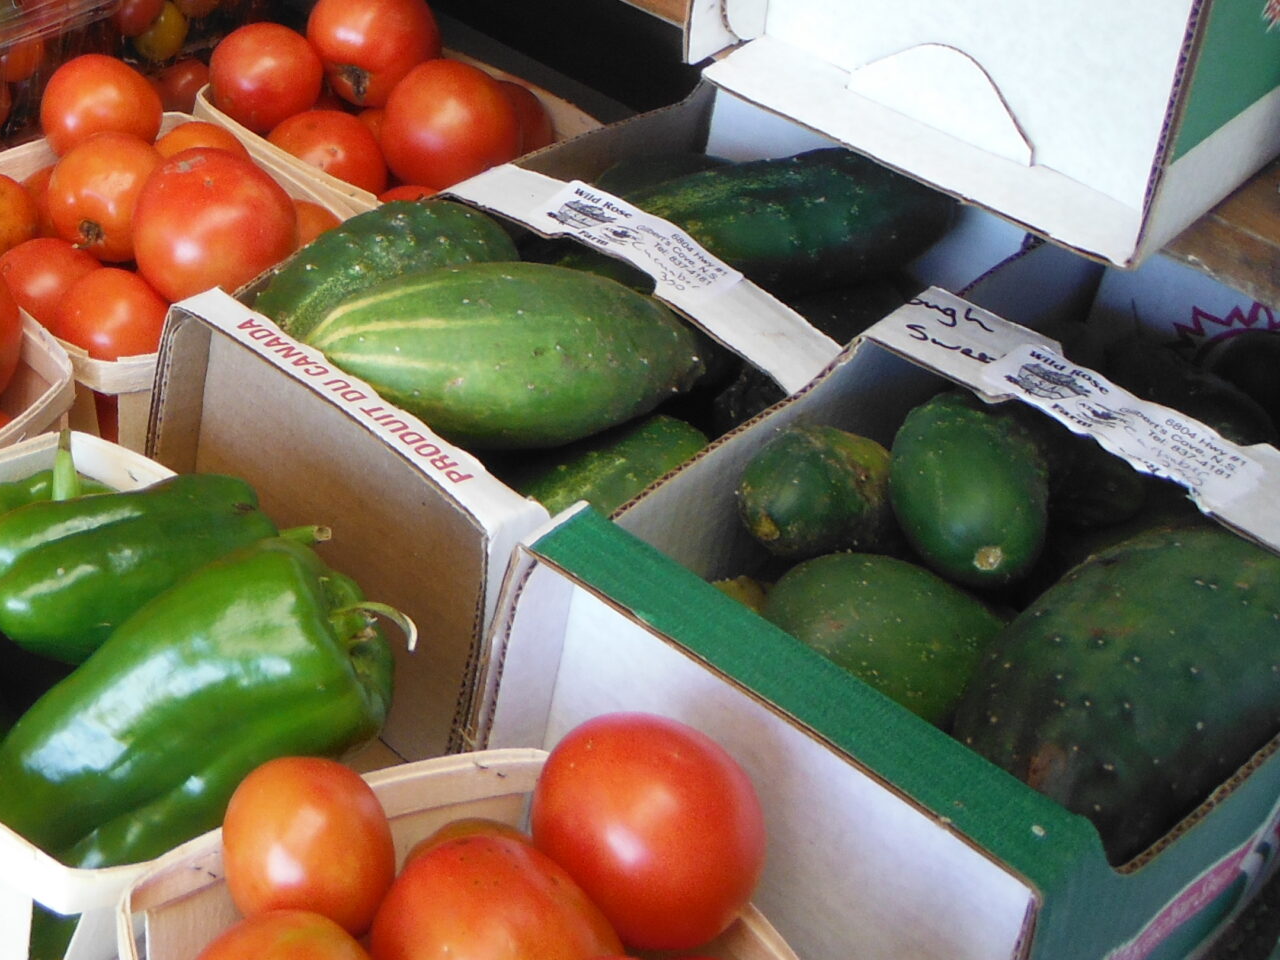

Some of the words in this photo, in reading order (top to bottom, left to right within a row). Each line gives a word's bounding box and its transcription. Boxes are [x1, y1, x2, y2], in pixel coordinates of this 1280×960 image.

[574, 188, 602, 204] Wild
[603, 201, 633, 218] Rose
[578, 230, 609, 246] Farm
[636, 224, 671, 247] Gilbert's
[671, 233, 694, 252] 6804
[693, 252, 715, 267] Hwy
[236, 318, 331, 378] CANADA
[1029, 350, 1067, 371] Wild
[1070, 369, 1110, 395] Rose
[323, 378, 369, 403] DU
[1051, 403, 1093, 428] Farm
[360, 405, 474, 484] PRODUIT
[1165, 418, 1197, 439] 6804
[1198, 438, 1228, 456] Hwy
[1229, 455, 1247, 467] #1
[1170, 445, 1232, 480] 837-4181
